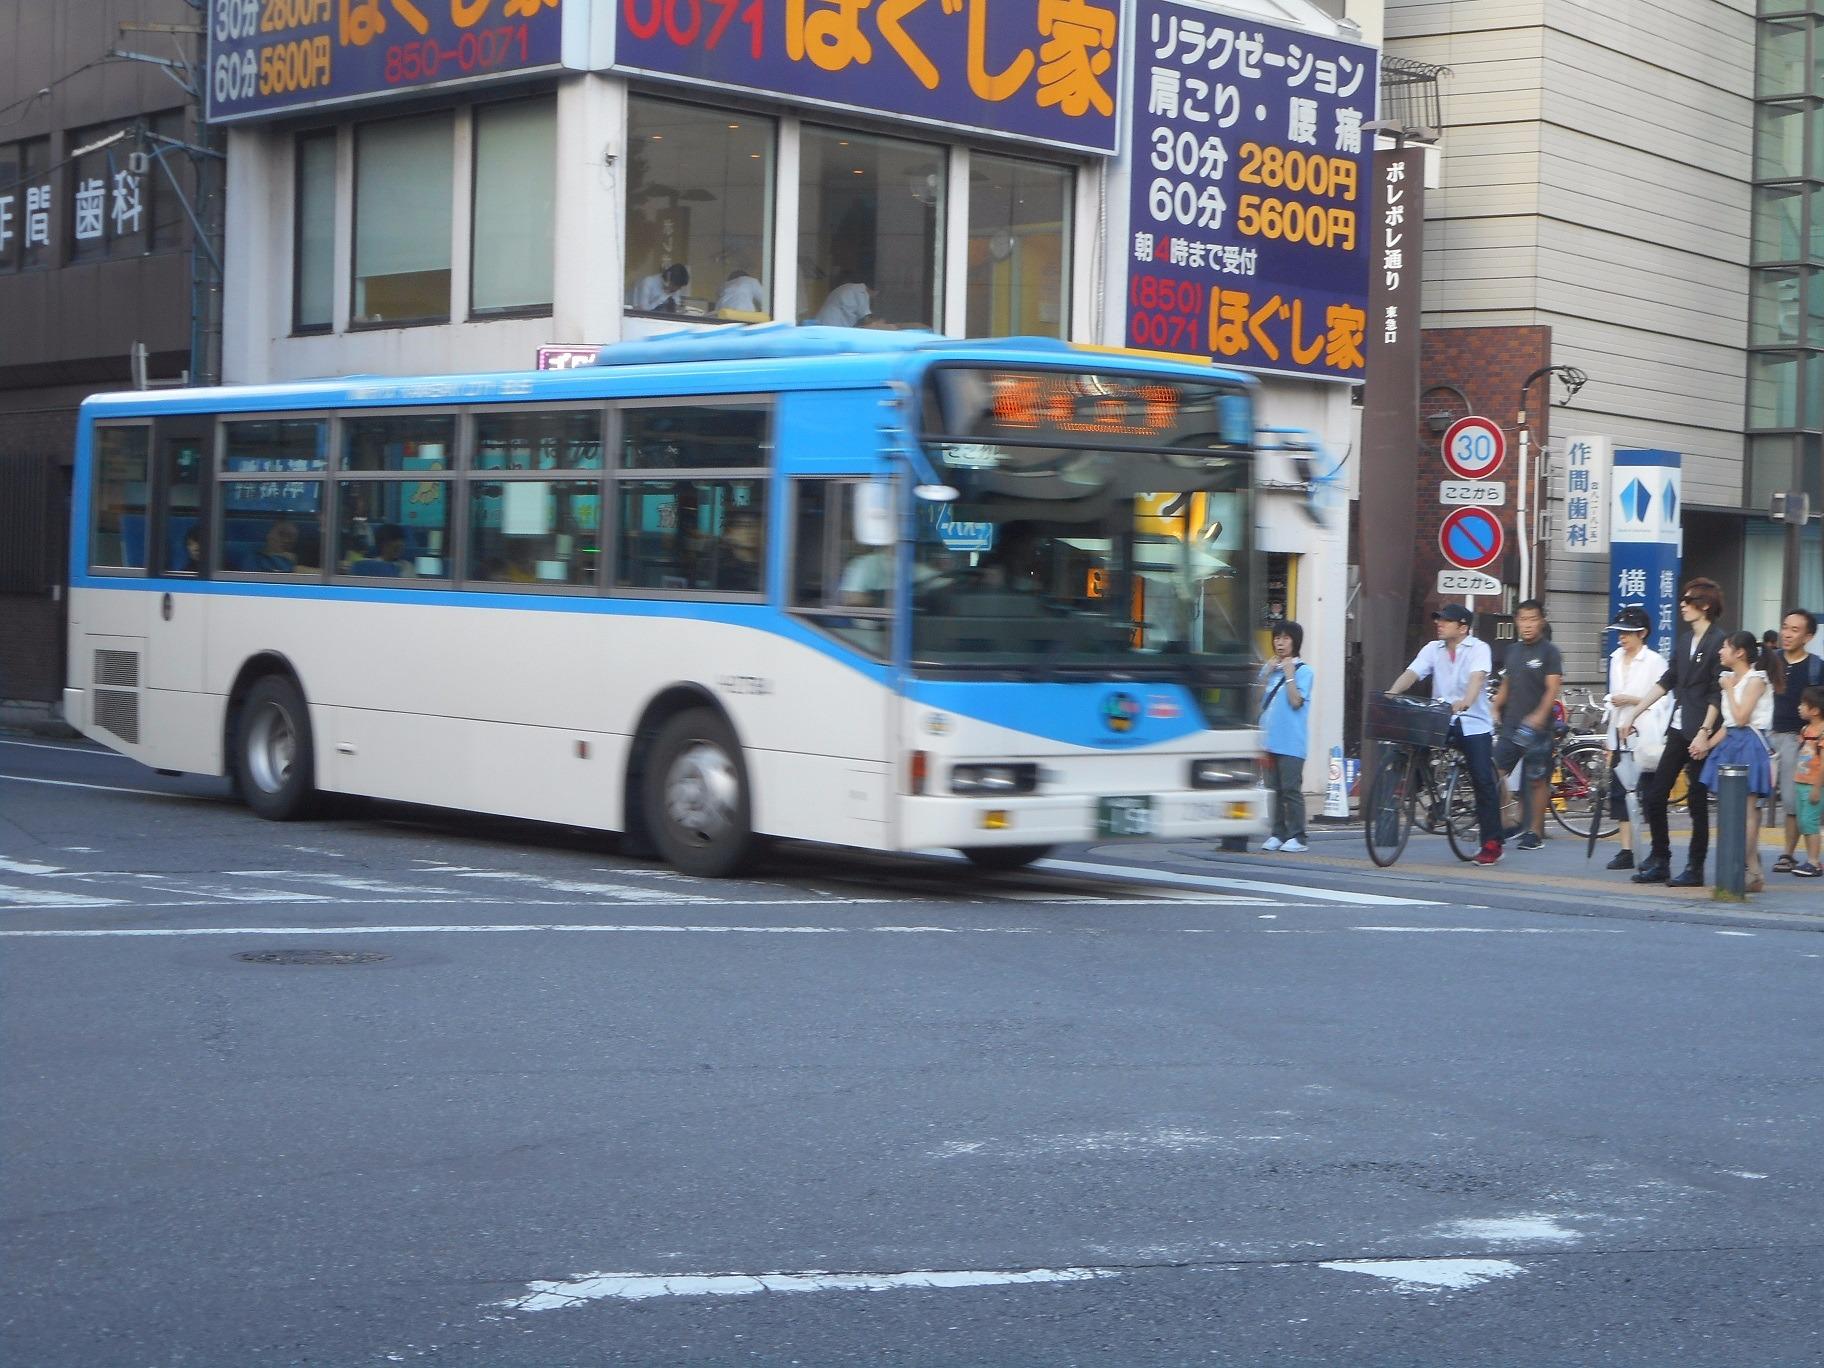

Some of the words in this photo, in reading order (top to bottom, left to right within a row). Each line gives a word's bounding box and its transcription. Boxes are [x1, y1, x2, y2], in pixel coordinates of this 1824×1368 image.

[216, 0, 259, 42] 30分
[215, 49, 258, 102] 60分
[259, 36, 330, 96] 5600円
[385, 24, 529, 83] 850-0071
[1151, 13, 1365, 98] リラクゼーション
[1151, 126, 1228, 180] 30分
[1238, 142, 1358, 201] 2800円
[1149, 177, 1227, 230] 60分
[1237, 195, 1356, 251] 5600円
[1383, 161, 1406, 291] ポレポレ通り
[1134, 231, 1258, 275] 朝4時まで受付
[1131, 311, 1200, 350] 0071
[1208, 285, 1366, 370] ほぐし家
[1384, 306, 1399, 344] 東急口
[1457, 434, 1491, 462] 30
[1445, 486, 1499, 500] ここから
[1567, 442, 1592, 547] 作間歯科
[1442, 575, 1496, 590] ここから
